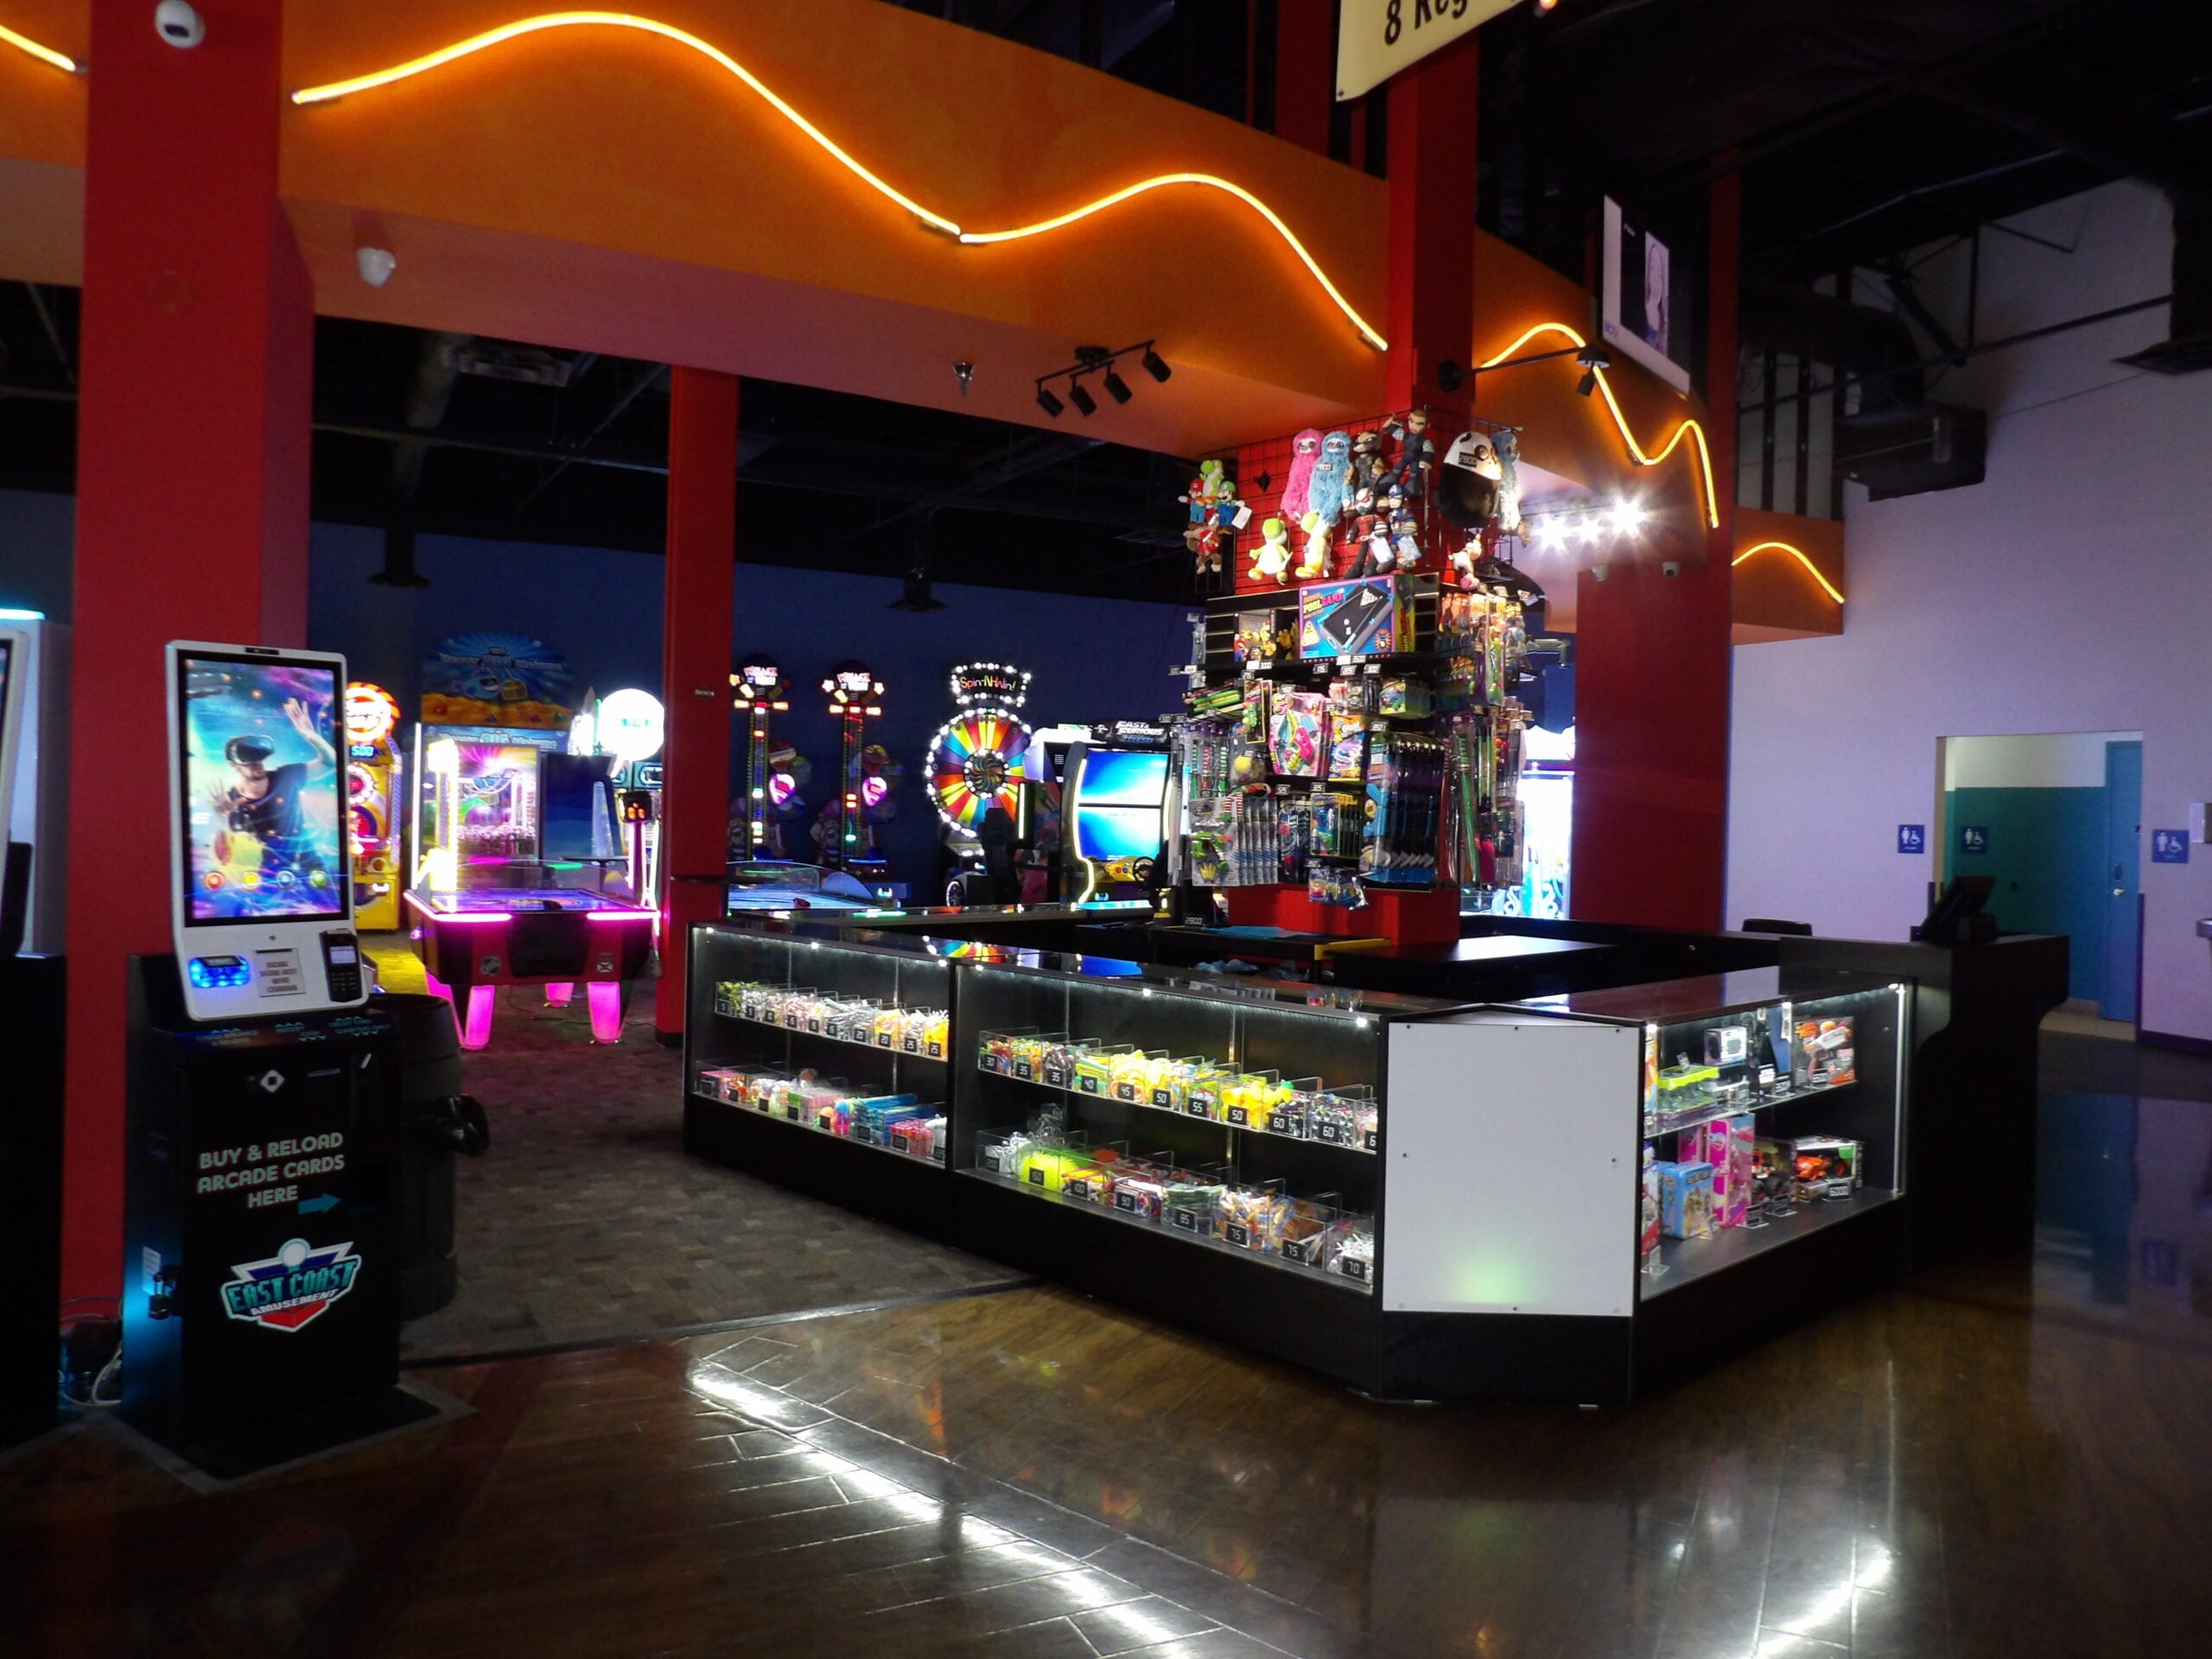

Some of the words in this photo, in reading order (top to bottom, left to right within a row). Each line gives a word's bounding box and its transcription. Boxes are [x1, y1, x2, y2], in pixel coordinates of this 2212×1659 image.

[1384, 0, 1401, 46] 8
[1303, 601, 1322, 613] POOL
[1119, 727, 1165, 736] FURIOUS
[1121, 1086, 1130, 1096] 45
[1156, 1092, 1166, 1103] 50
[1192, 1101, 1203, 1113] 55
[1231, 1109, 1243, 1121] 50
[1273, 1117, 1285, 1128] 60
[1322, 1125, 1334, 1137] 60
[1369, 1135, 1376, 1147] 6
[199, 1148, 243, 1169] BUY
[248, 1143, 264, 1160] &
[268, 1131, 345, 1158] RELOAD
[197, 1166, 279, 1195] ARCADE
[283, 1154, 346, 1179] CARDS
[247, 1185, 299, 1209] HERE
[1121, 1196, 1131, 1207] 90
[1287, 1243, 1299, 1257] 75
[1348, 1260, 1360, 1274] 70
[226, 1274, 283, 1313] EAST
[287, 1259, 359, 1300] COAST
[250, 1288, 340, 1318] AMUSEMENT
